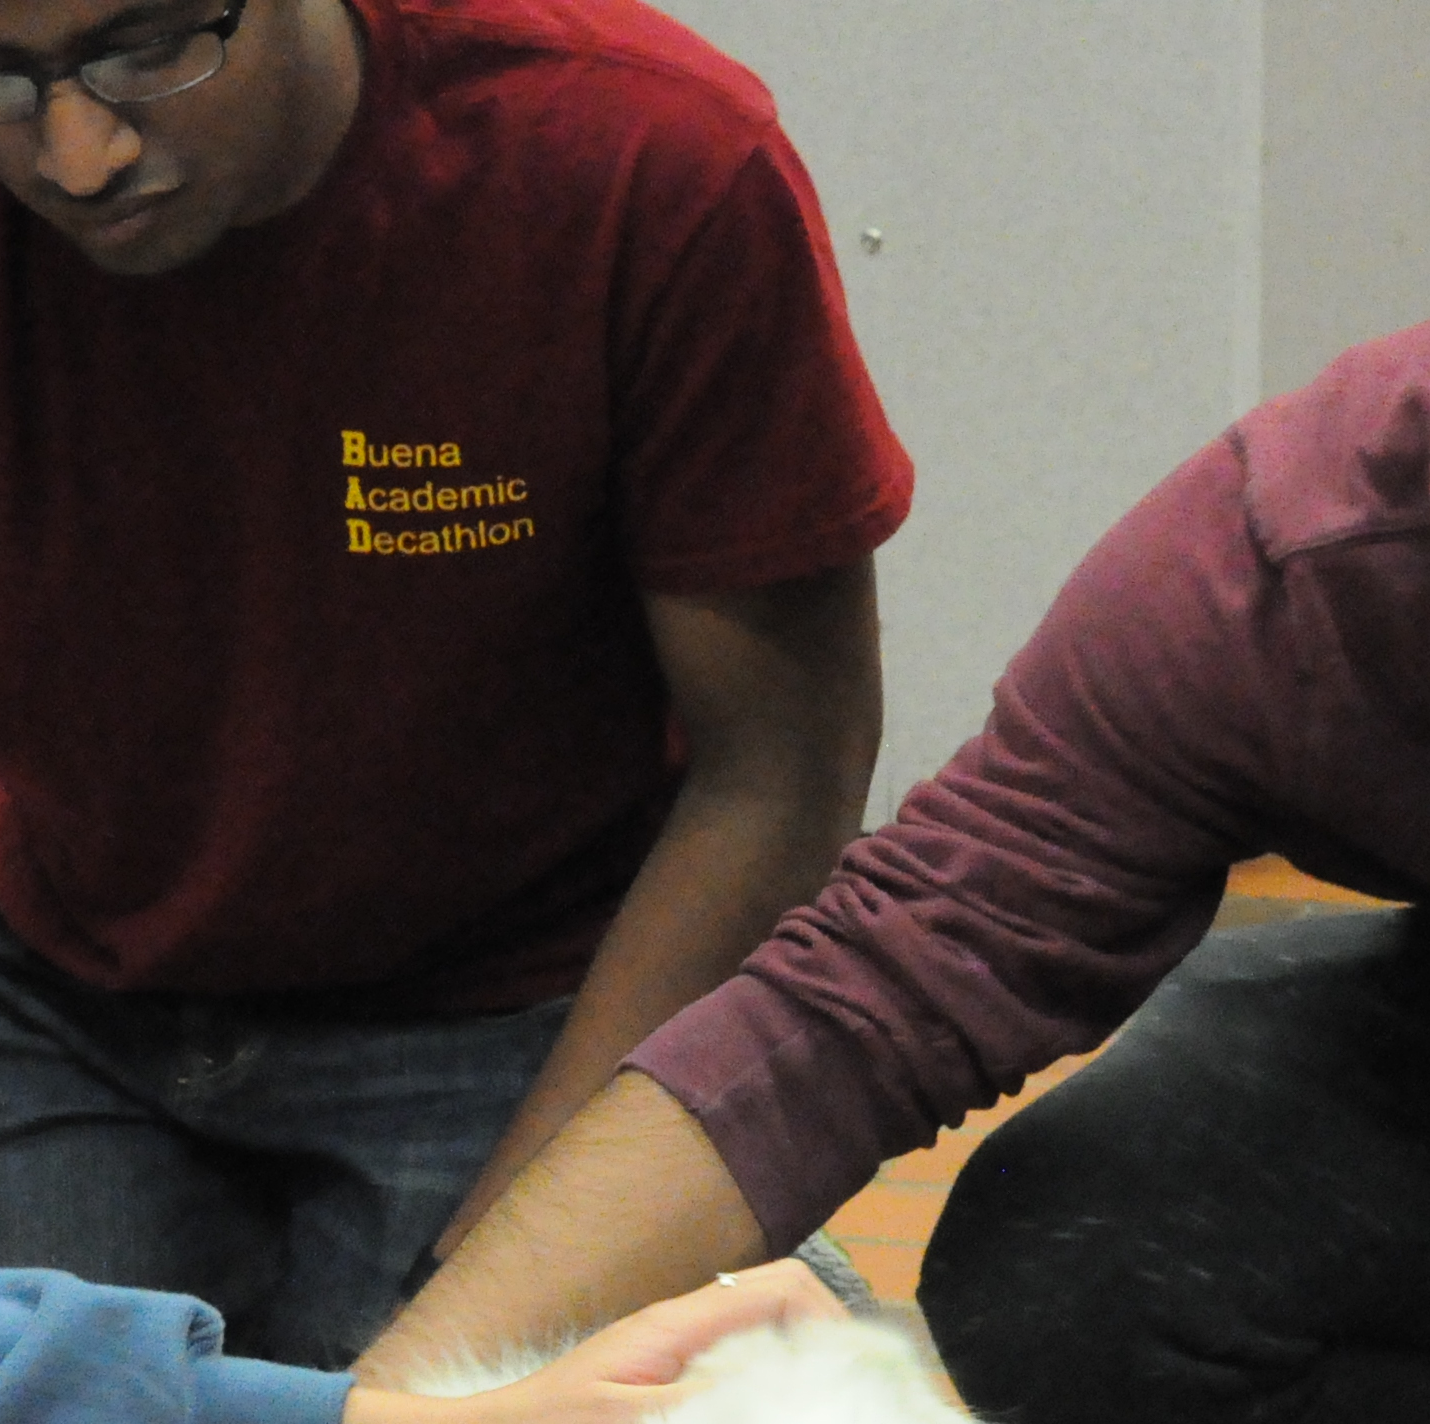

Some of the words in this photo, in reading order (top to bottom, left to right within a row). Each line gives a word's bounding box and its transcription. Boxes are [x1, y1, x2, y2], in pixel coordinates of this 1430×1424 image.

[341, 430, 462, 467] Buena
[345, 476, 527, 512] Academic
[346, 518, 534, 554] Decathlon
